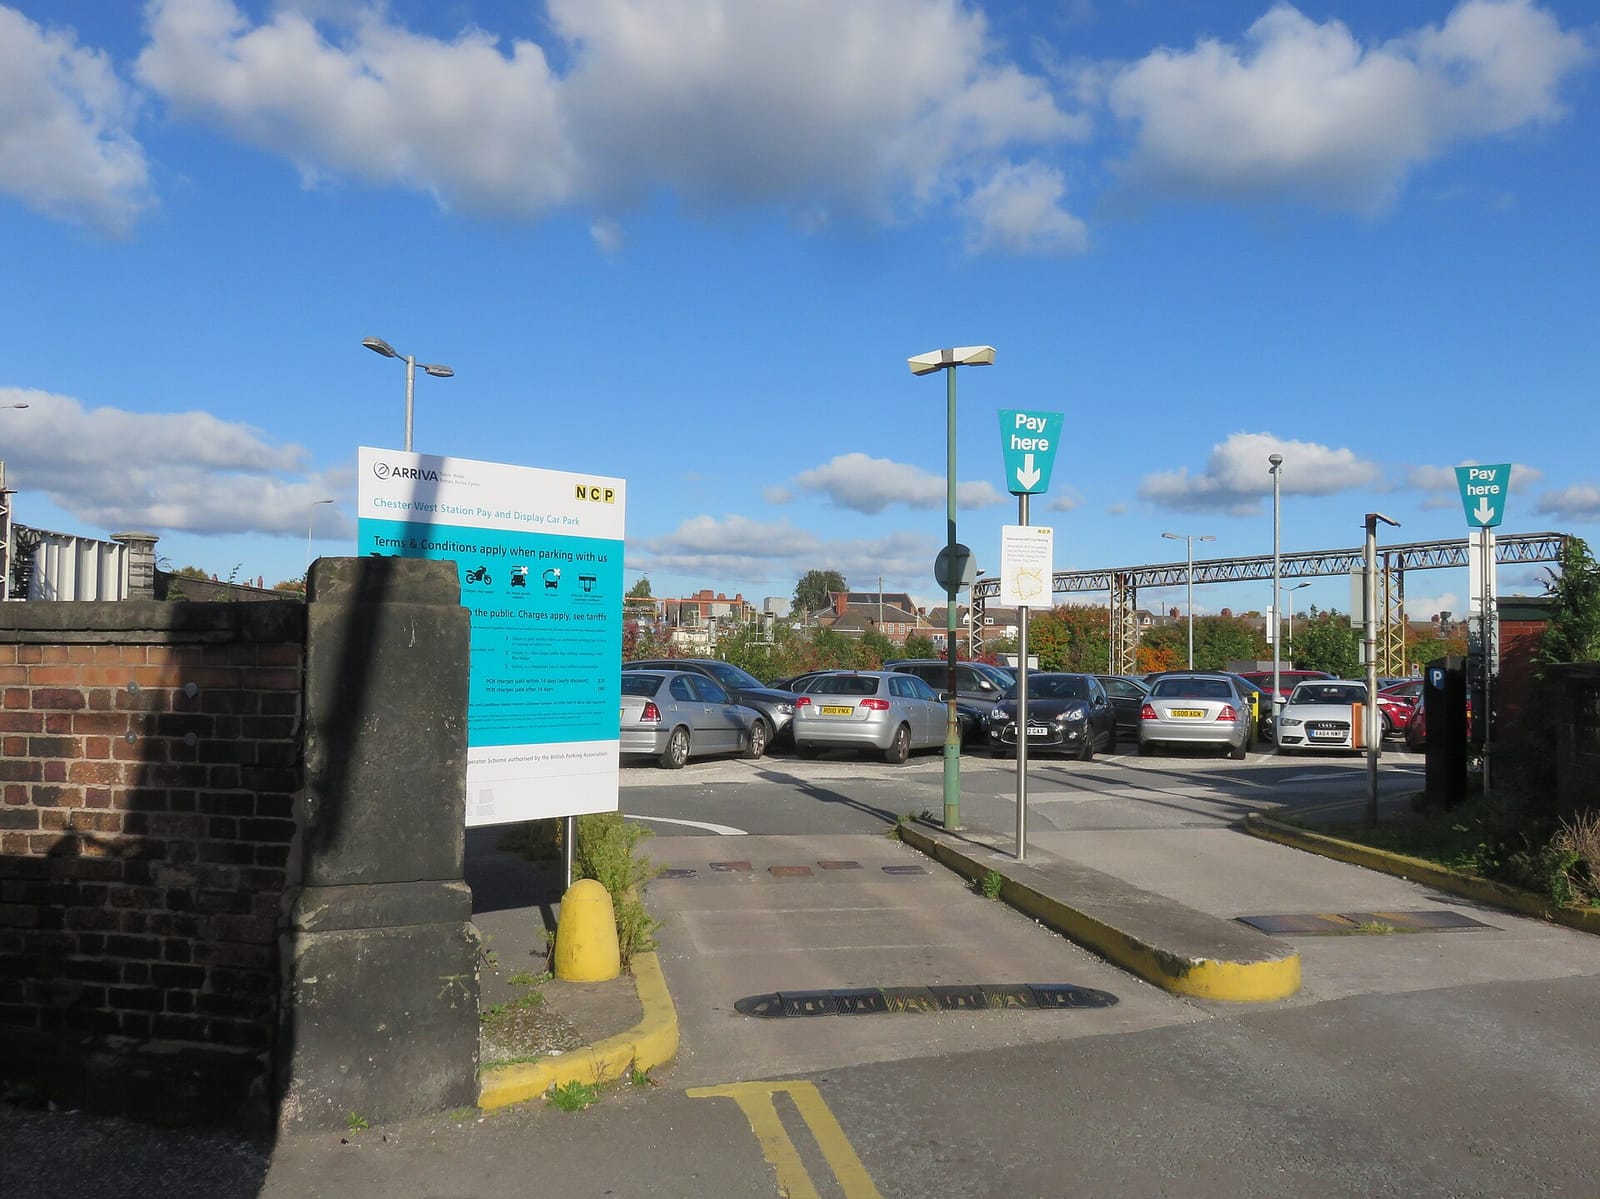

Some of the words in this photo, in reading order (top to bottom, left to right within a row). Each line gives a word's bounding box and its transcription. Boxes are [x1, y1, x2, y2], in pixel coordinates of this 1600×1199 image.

[1015, 413, 1047, 433] Pay
[1011, 433, 1049, 451] here
[392, 466, 439, 482] ARRIVA
[1469, 468, 1497, 481] Pay
[576, 486, 613, 502] NCP
[1466, 483, 1500, 496] here
[373, 497, 411, 509] Chester
[413, 501, 438, 512] West
[441, 503, 474, 515] Station
[477, 507, 492, 519] Pay
[495, 510, 511, 519] and
[513, 511, 544, 524] Display
[546, 514, 560, 524] Car
[562, 516, 580, 526] Park
[374, 535, 406, 548] Terms
[409, 538, 417, 549] &
[420, 539, 477, 553] Conditions
[479, 544, 507, 558] apply
[510, 546, 536, 557] when
[538, 549, 573, 562] parking
[576, 552, 595, 562] with
[598, 554, 608, 563] us
[475, 608, 488, 617] the
[518, 609, 548, 621] Charges
[573, 613, 584, 621] see
[586, 612, 607, 621] tariffs
[1433, 670, 1442, 687] P
[467, 758, 487, 766] perator
[507, 755, 534, 763] authorised
[566, 752, 582, 760] Parking
